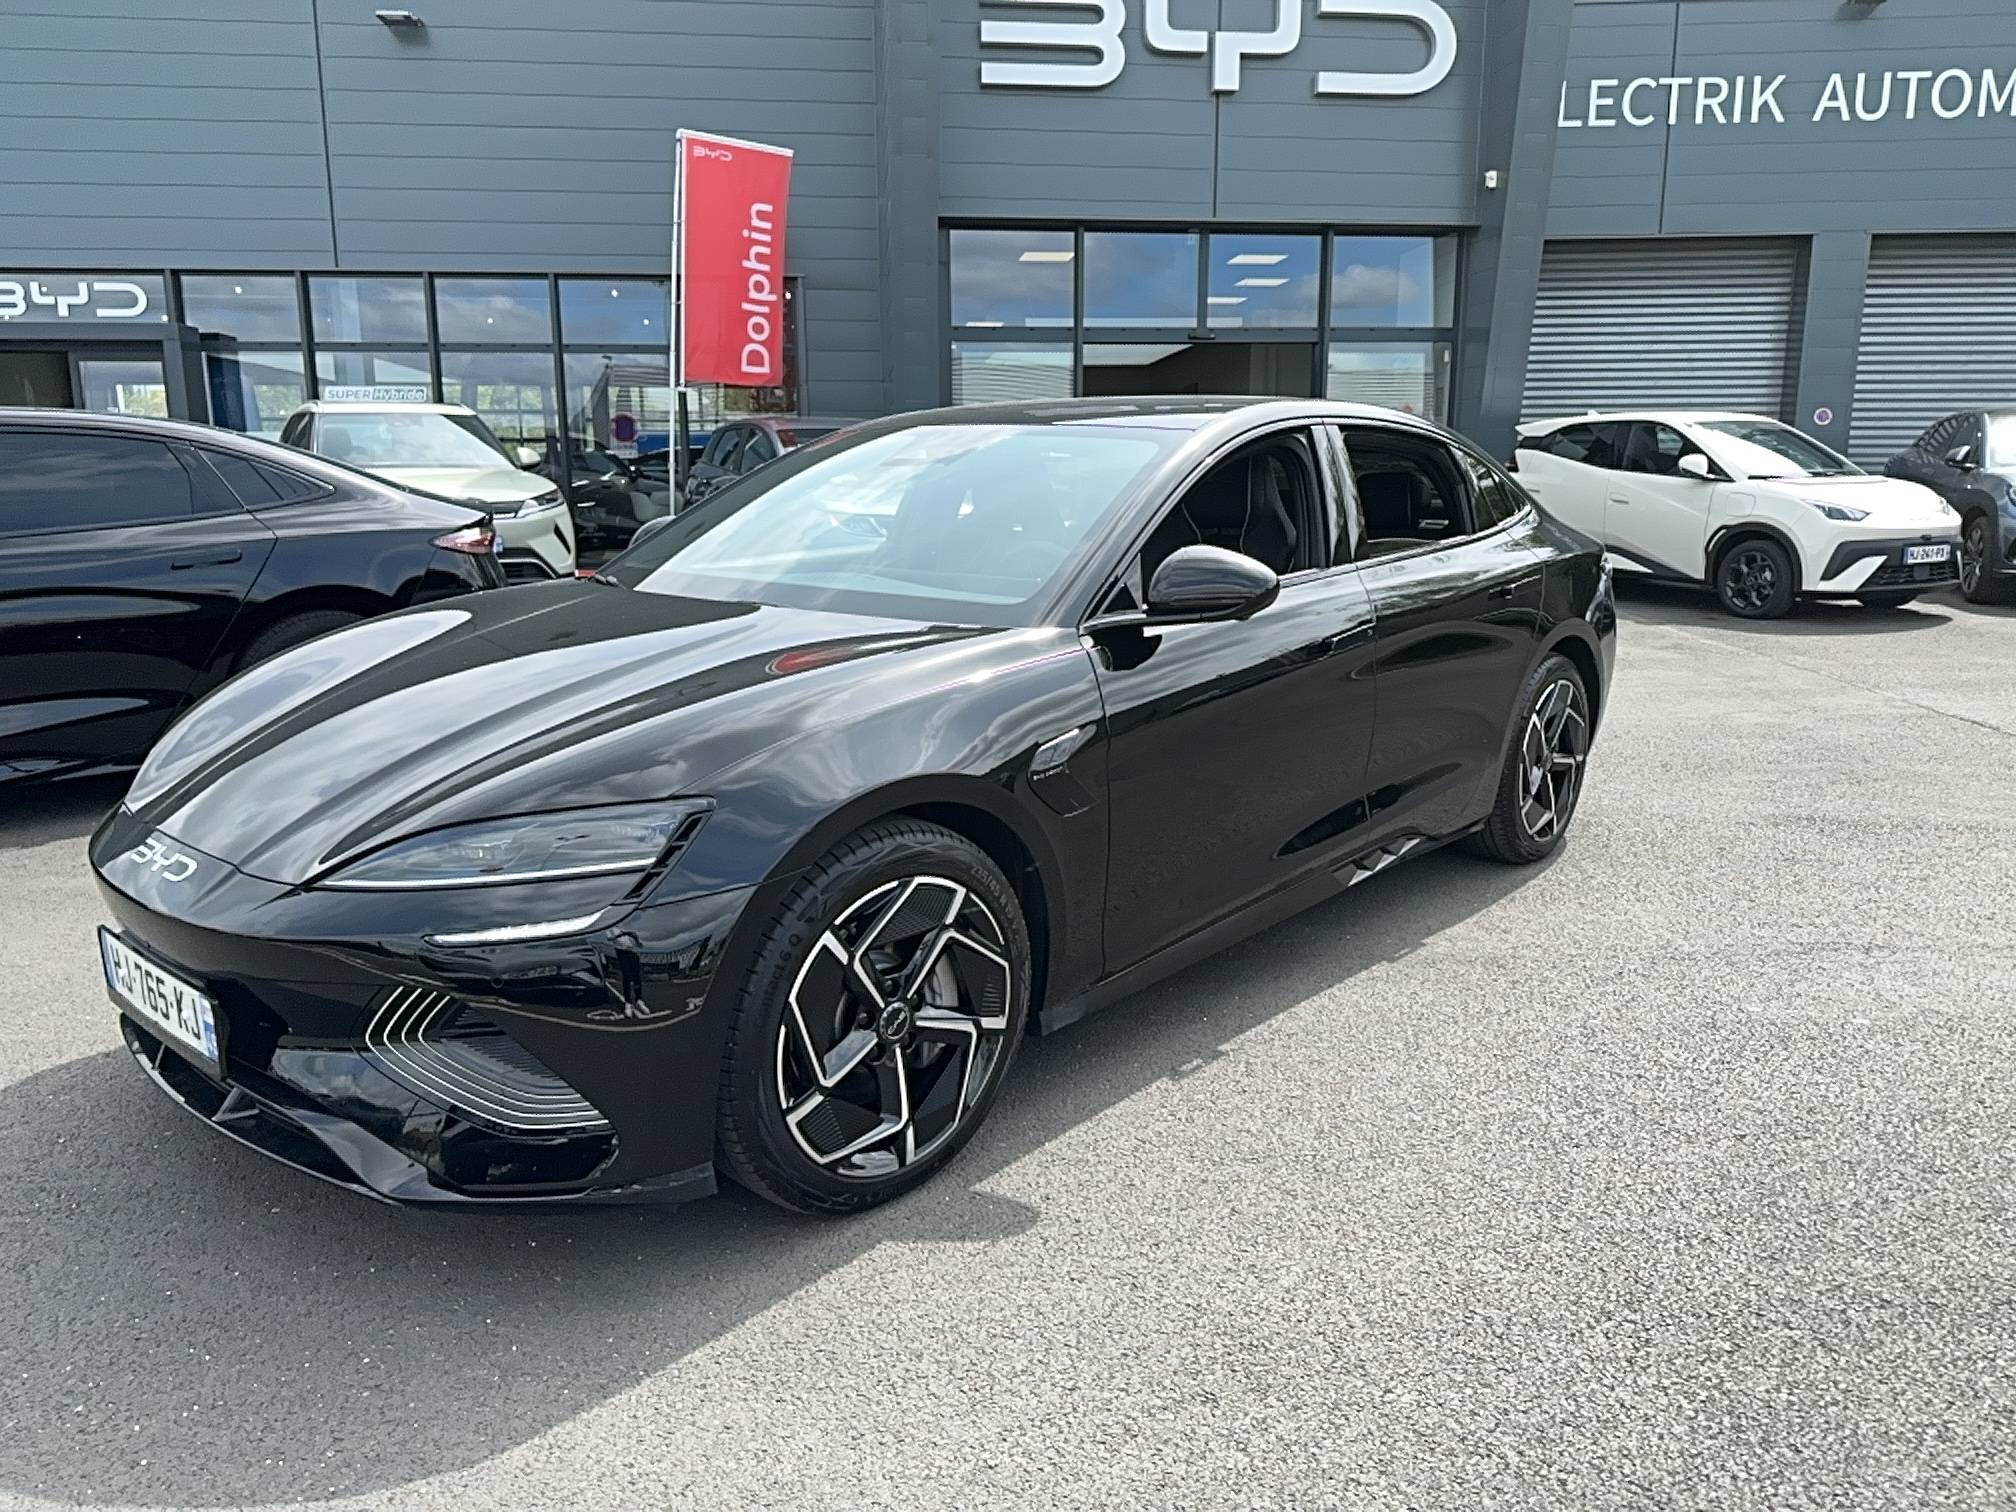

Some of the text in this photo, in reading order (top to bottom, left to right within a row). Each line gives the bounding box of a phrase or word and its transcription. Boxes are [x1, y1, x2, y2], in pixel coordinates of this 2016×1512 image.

[980, 0, 1457, 96] BYD
[1812, 68, 2016, 122] AUTOM
[693, 145, 733, 162] BYD
[740, 202, 777, 374] Dolphin
[327, 388, 371, 400] SUPER
[130, 837, 198, 882] BYD
